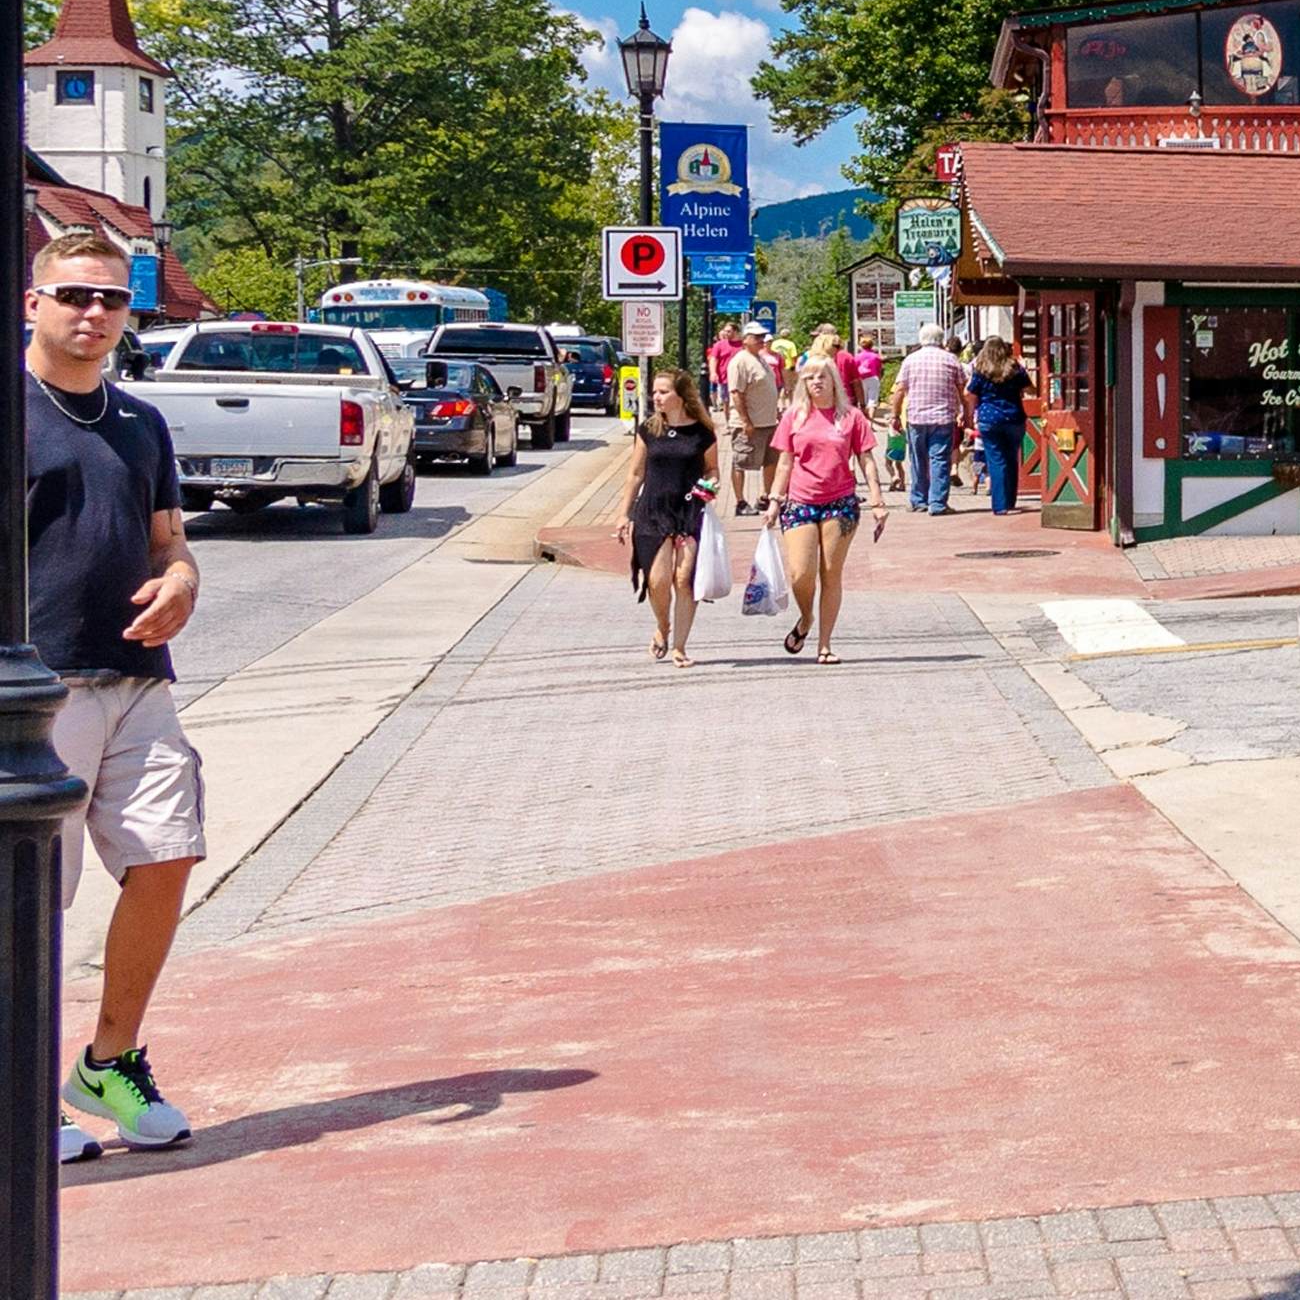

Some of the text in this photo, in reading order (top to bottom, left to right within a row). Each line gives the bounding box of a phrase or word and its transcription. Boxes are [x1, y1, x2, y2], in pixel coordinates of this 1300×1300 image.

[680, 202, 731, 219] Alpine
[911, 215, 953, 229] Helen's
[683, 223, 728, 237] Helen
[903, 228, 957, 240] Treasures
[632, 242, 656, 270] P
[637, 307, 651, 317] NO
[1248, 338, 1289, 367] Hot
[1260, 388, 1285, 406] Ice
